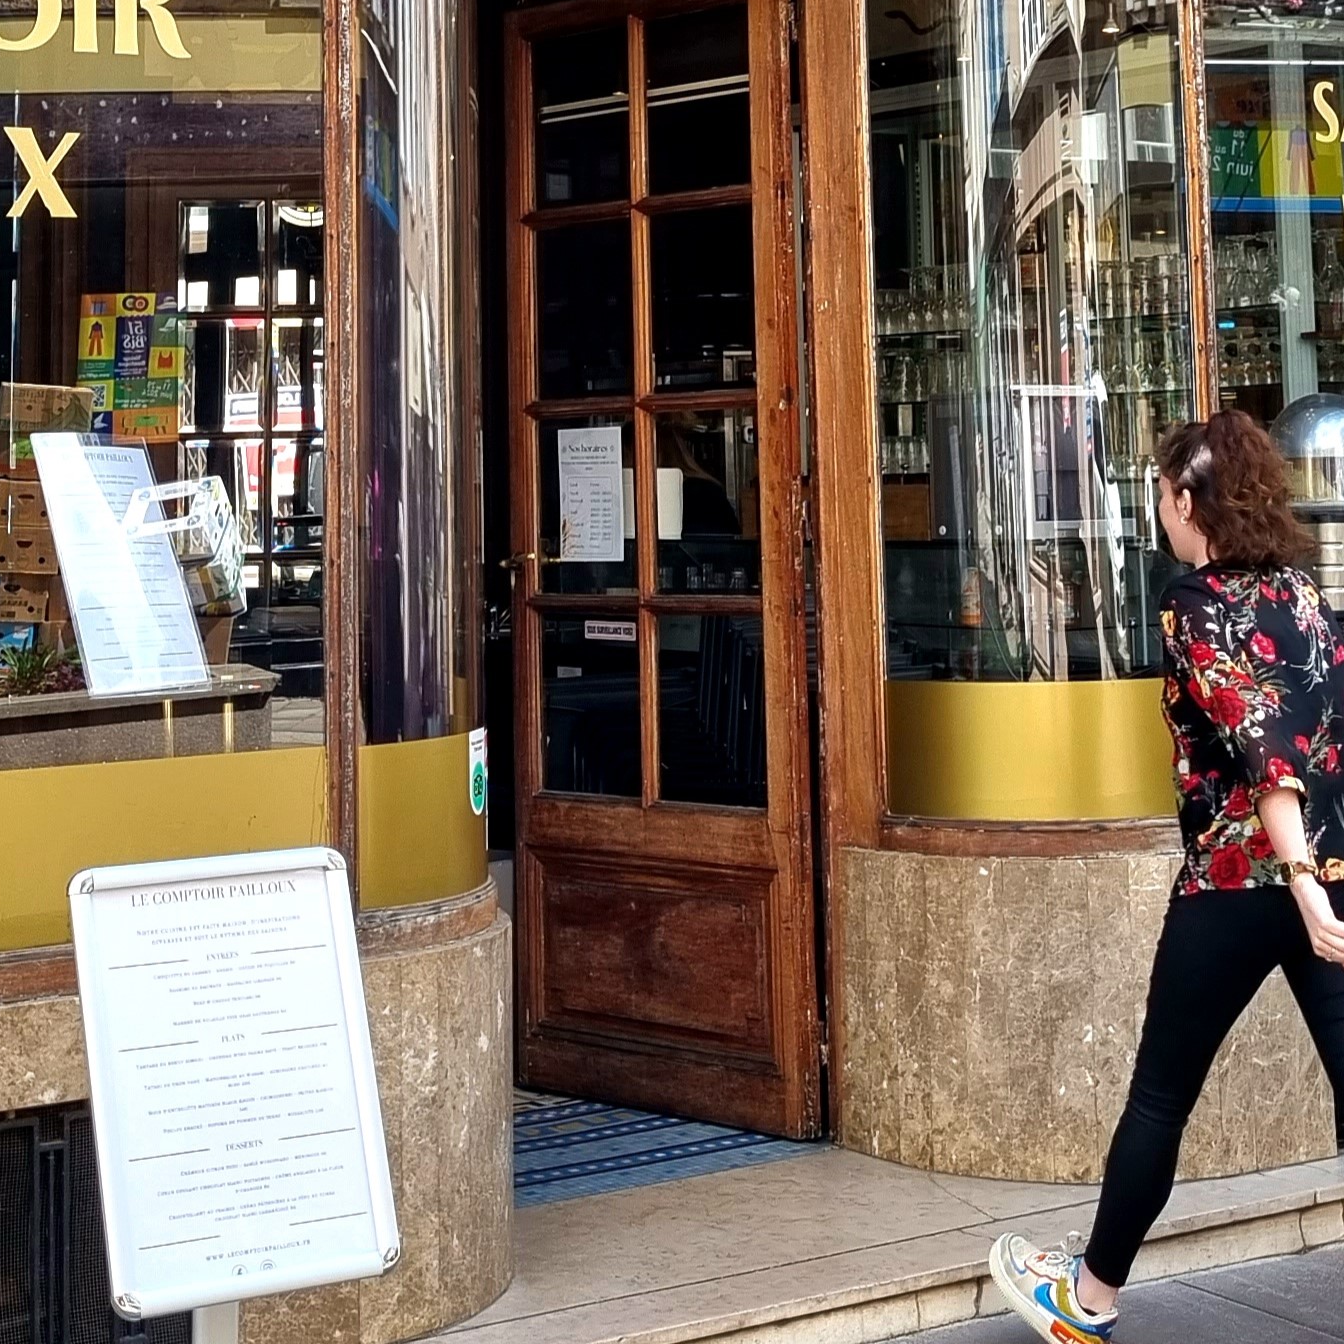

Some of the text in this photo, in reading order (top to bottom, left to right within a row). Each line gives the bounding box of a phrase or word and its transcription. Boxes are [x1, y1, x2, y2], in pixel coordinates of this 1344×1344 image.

[131, 879, 297, 908] LE COMPTOIR PAILLOUX
[225, 1139, 264, 1152] DESSERTS
